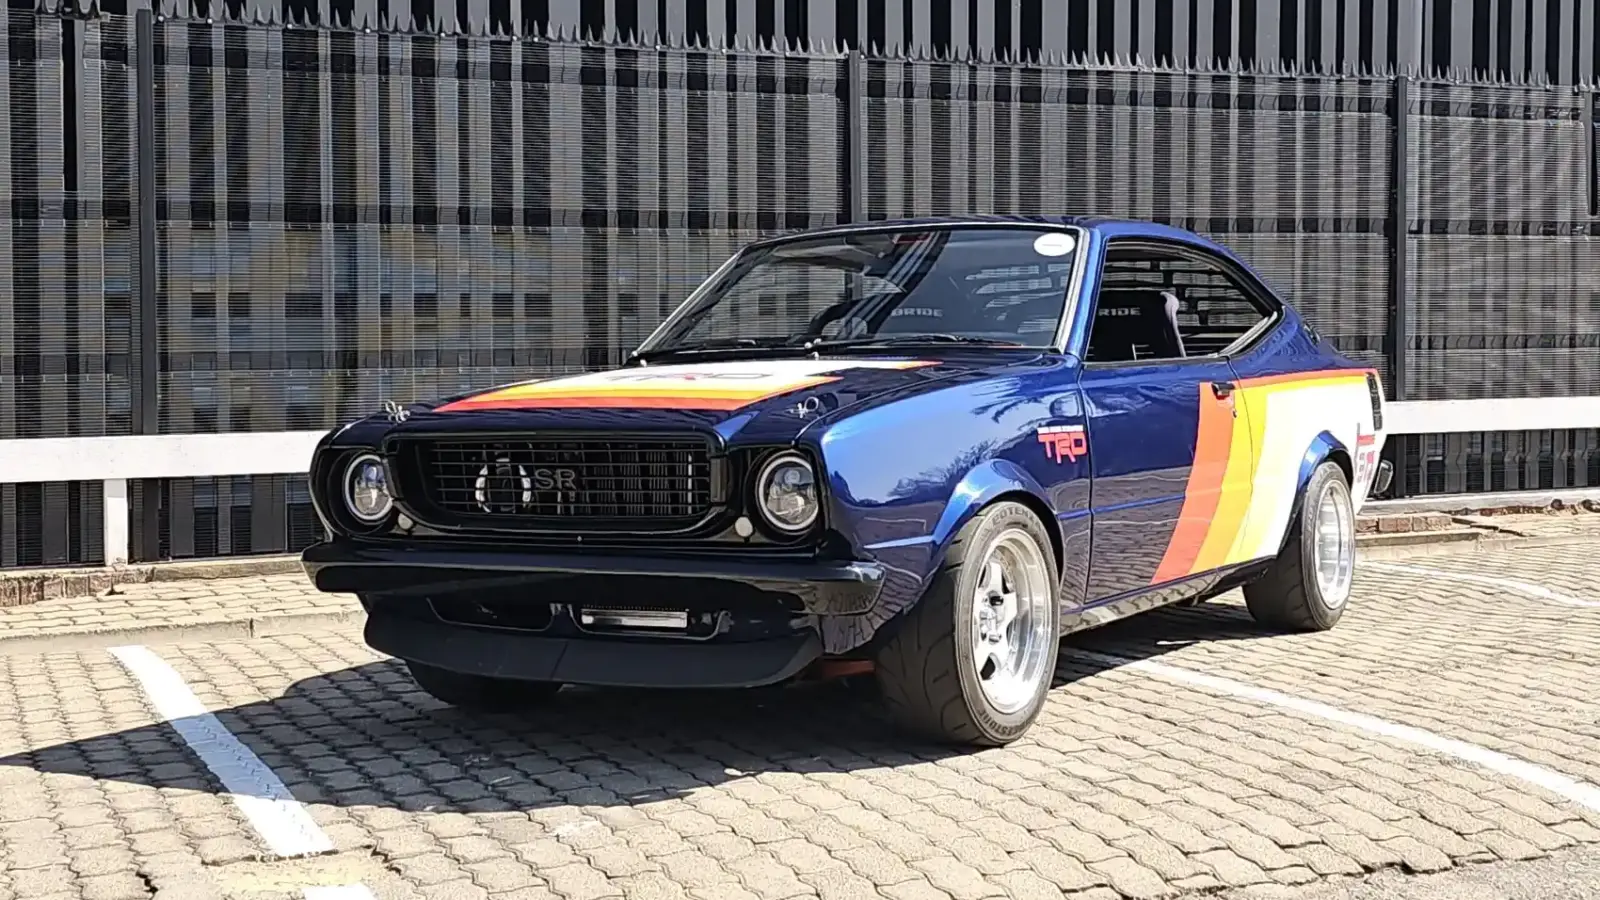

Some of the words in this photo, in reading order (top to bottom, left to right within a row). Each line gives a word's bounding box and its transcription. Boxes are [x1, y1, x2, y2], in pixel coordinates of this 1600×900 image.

[891, 307, 944, 317] BRIDE
[1098, 307, 1141, 316] RIDE
[1038, 432, 1087, 464] TRD
[535, 468, 577, 490] SR
